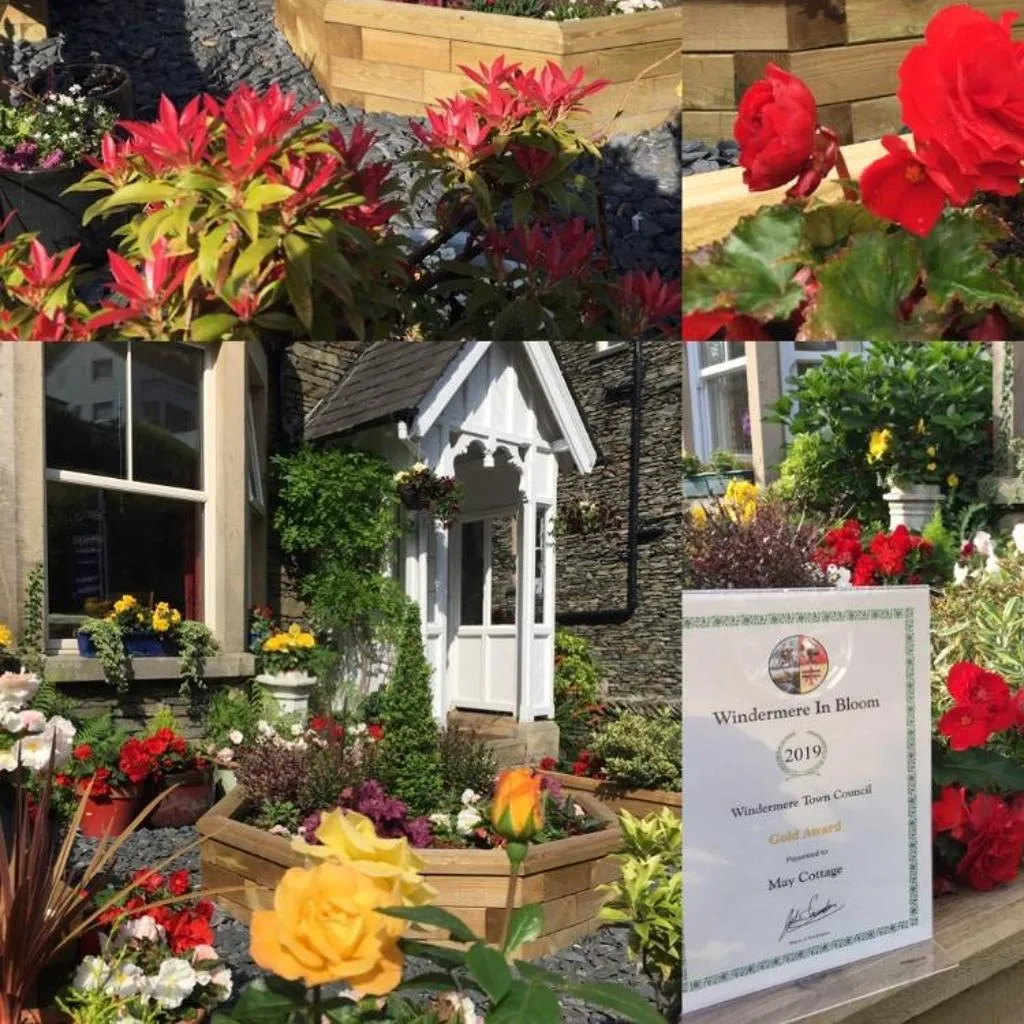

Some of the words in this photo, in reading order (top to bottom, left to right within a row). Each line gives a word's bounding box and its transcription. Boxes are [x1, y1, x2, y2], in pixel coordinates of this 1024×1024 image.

[712, 705, 811, 726] Windermere
[815, 701, 831, 715] In
[835, 697, 880, 713] Bloom
[784, 744, 822, 763] 2019
[730, 798, 799, 819] Windermere
[802, 793, 831, 807] Town
[833, 784, 873, 801] Council
[768, 828, 800, 845] Gold
[803, 820, 843, 840] Award
[767, 876, 796, 891] May
[798, 865, 844, 883] Cottage
